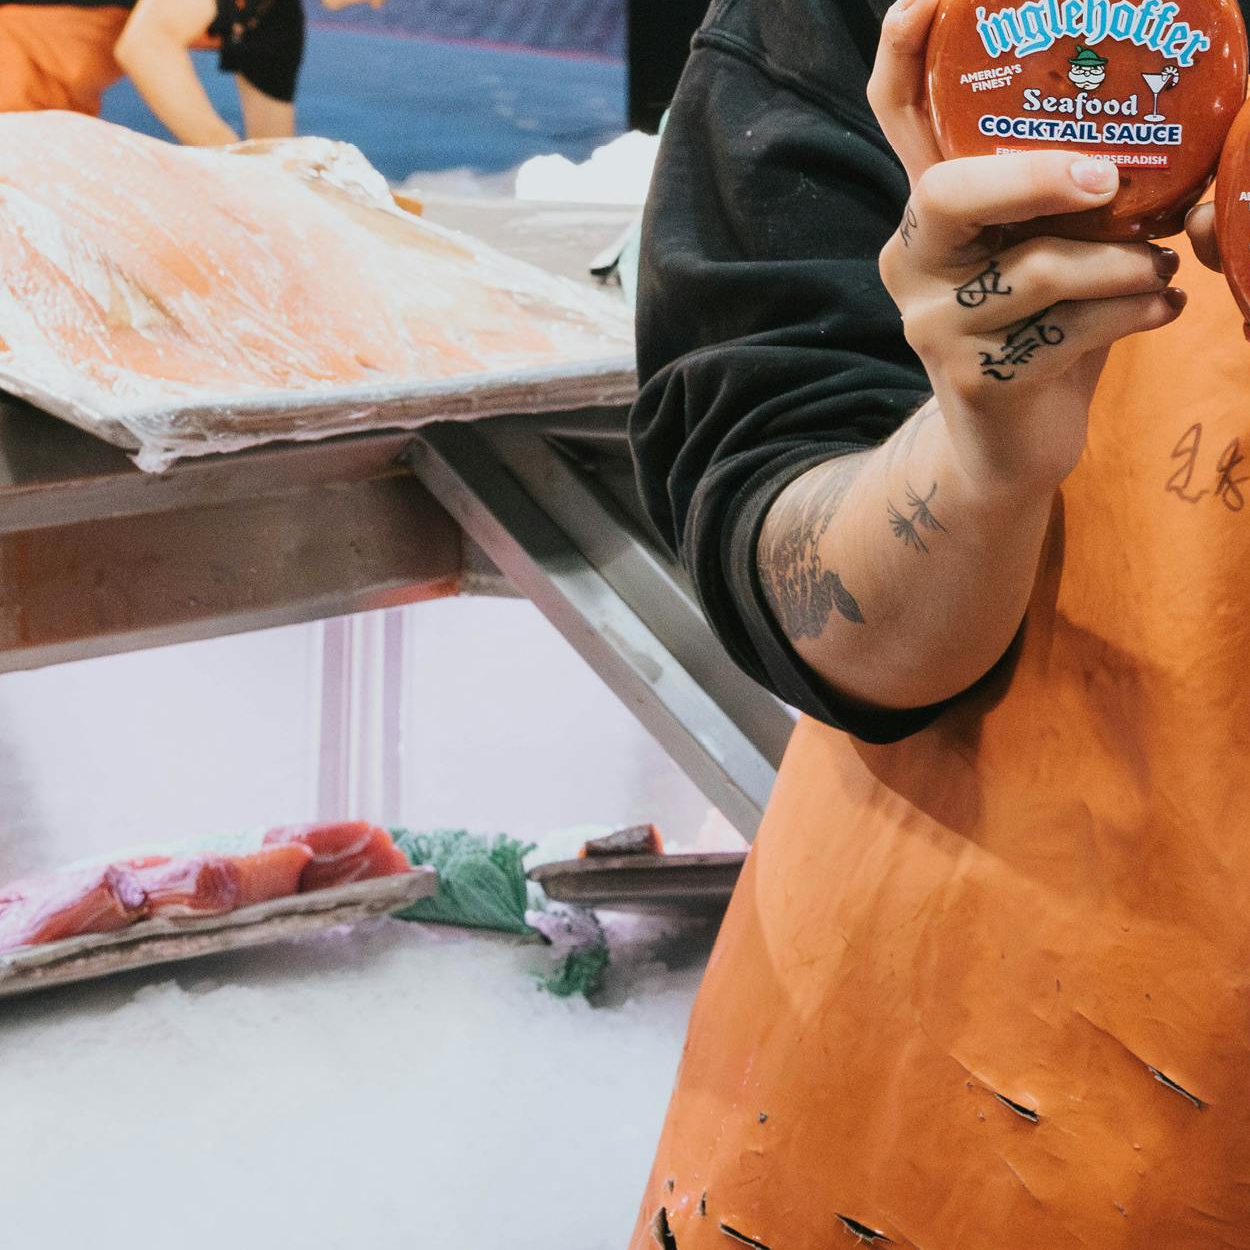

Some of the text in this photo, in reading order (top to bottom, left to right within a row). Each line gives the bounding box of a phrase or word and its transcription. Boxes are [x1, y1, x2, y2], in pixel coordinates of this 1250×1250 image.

[960, 64, 1022, 85] AMERICA'S
[971, 76, 1012, 92] FINEST
[1023, 89, 1138, 120] Seafood
[979, 115, 1182, 145] COCKTAIL SAUCE
